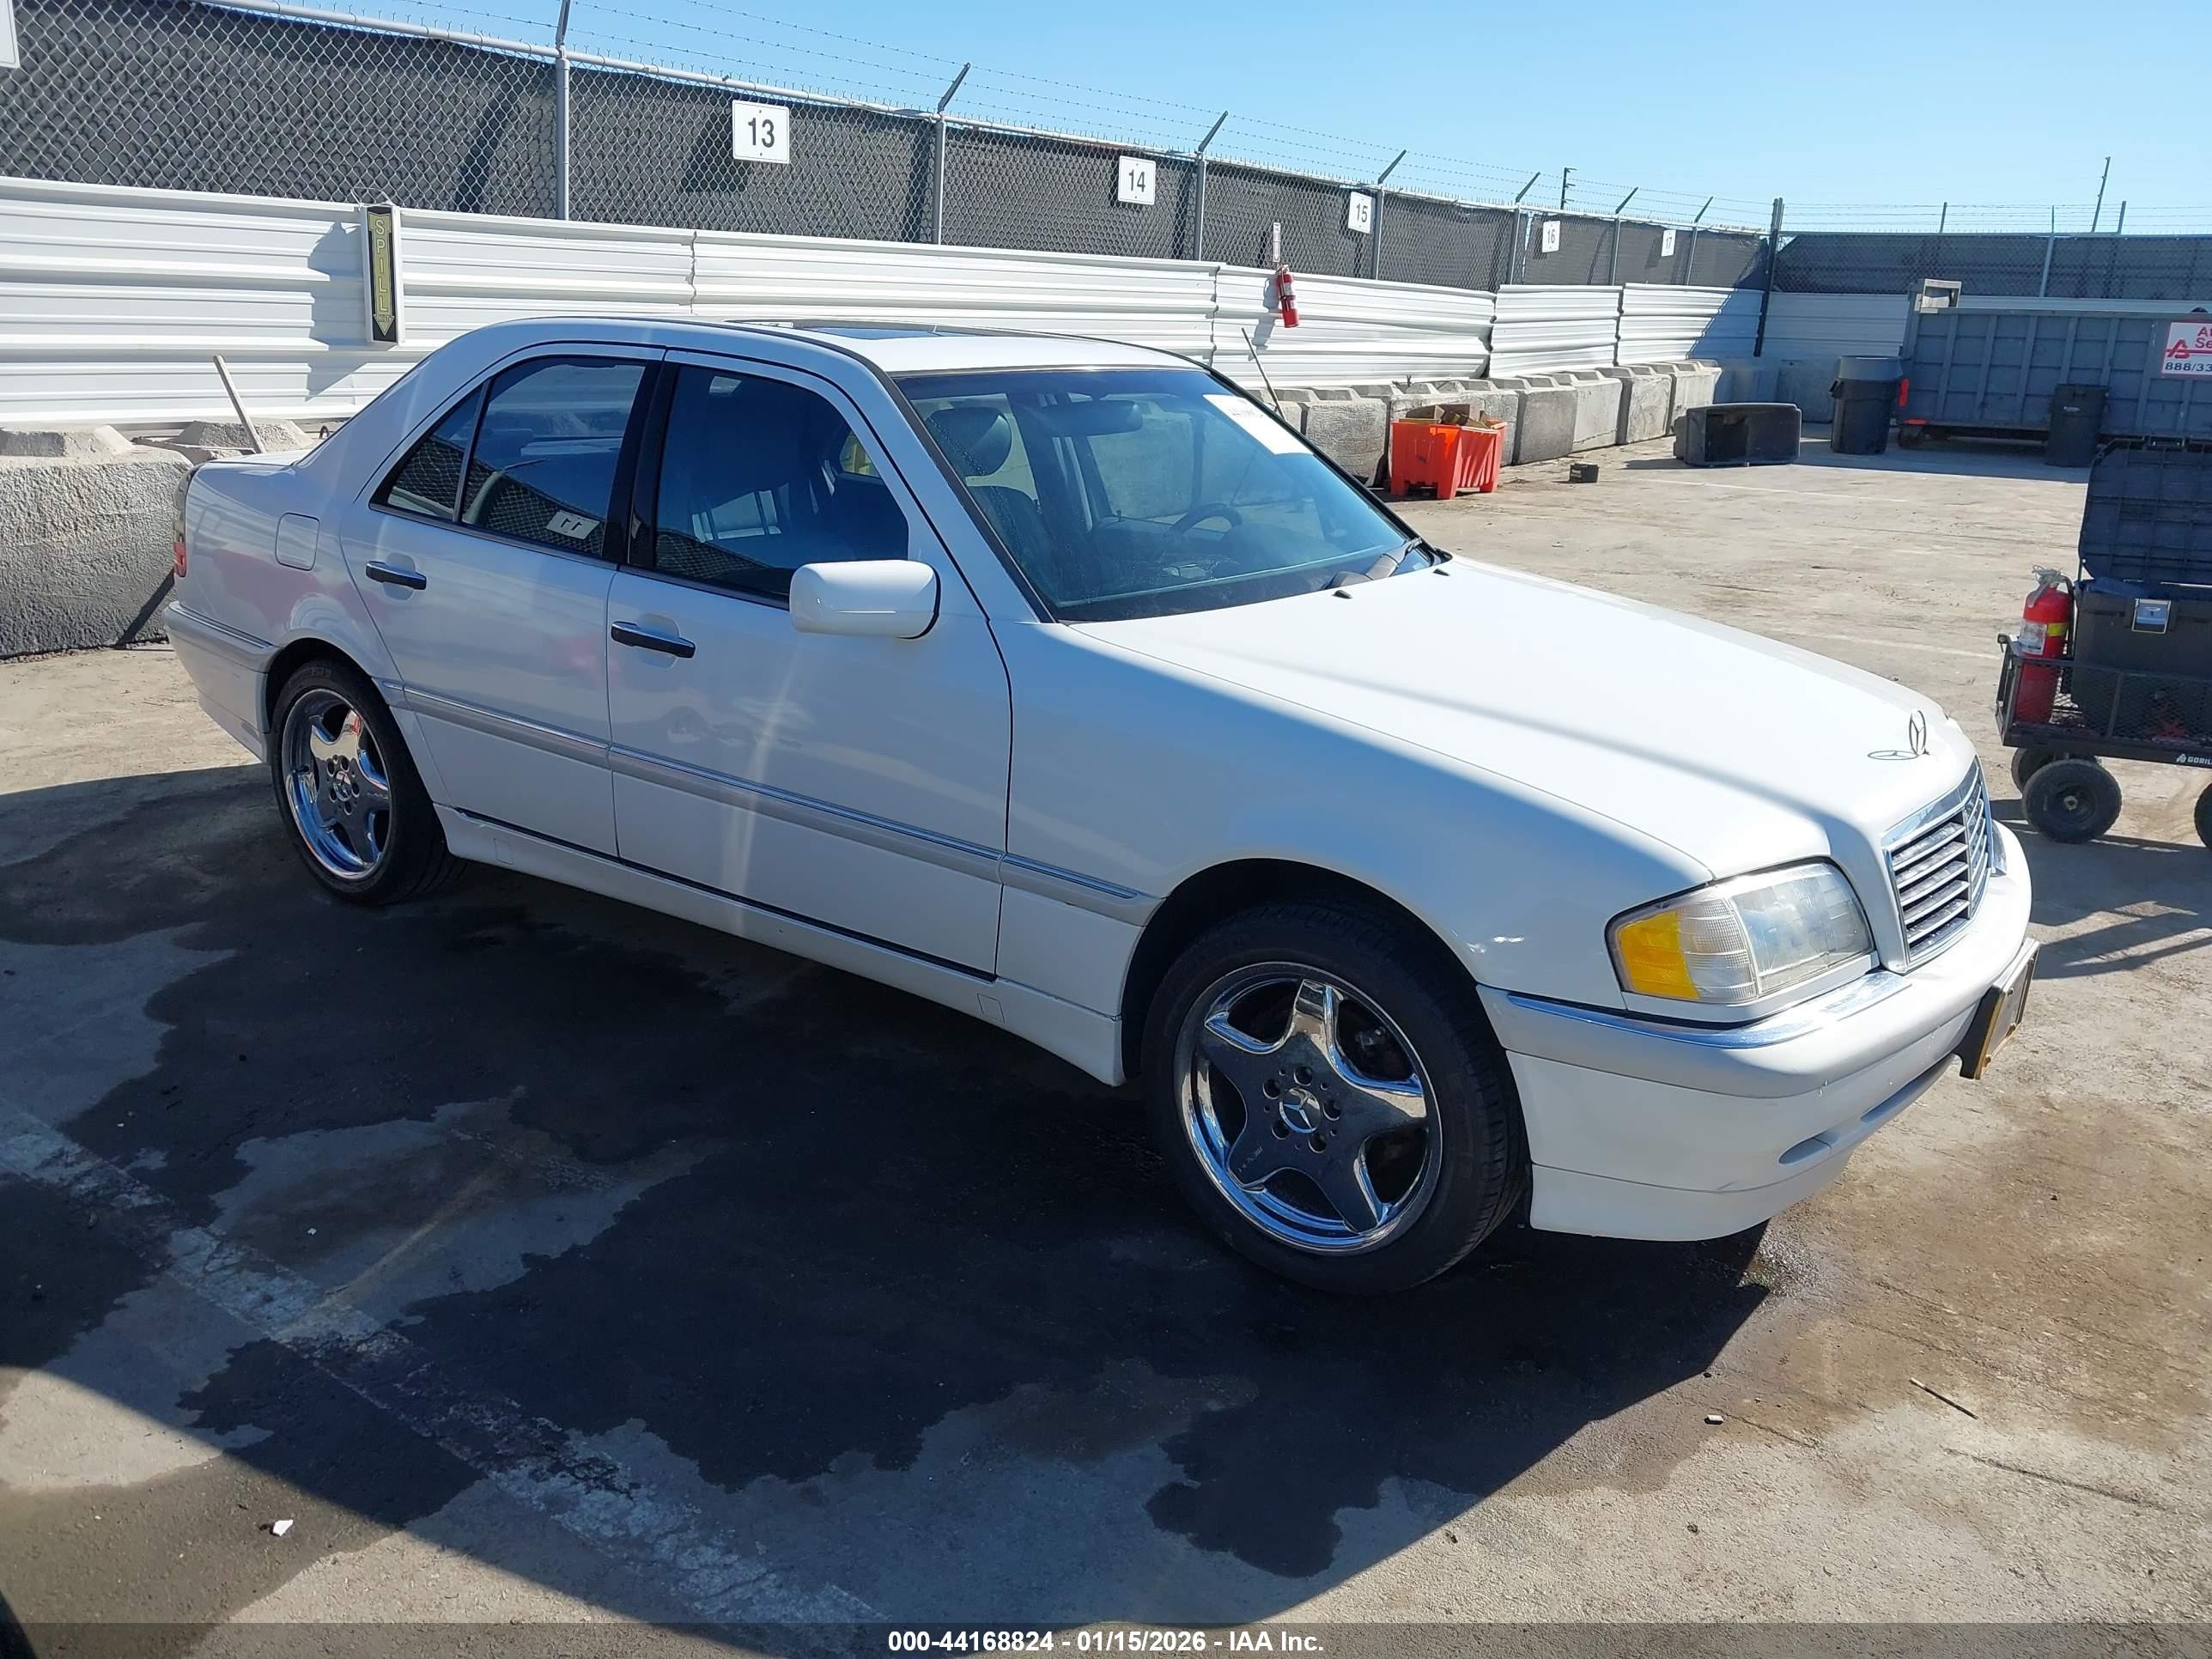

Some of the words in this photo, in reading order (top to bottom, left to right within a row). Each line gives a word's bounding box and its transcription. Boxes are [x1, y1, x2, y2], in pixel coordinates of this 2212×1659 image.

[748, 117, 775, 148] 13
[1128, 169, 1146, 192] 14
[1356, 203, 1368, 222] 15
[1547, 228, 1555, 244] 16
[375, 219, 388, 312] SPILL
